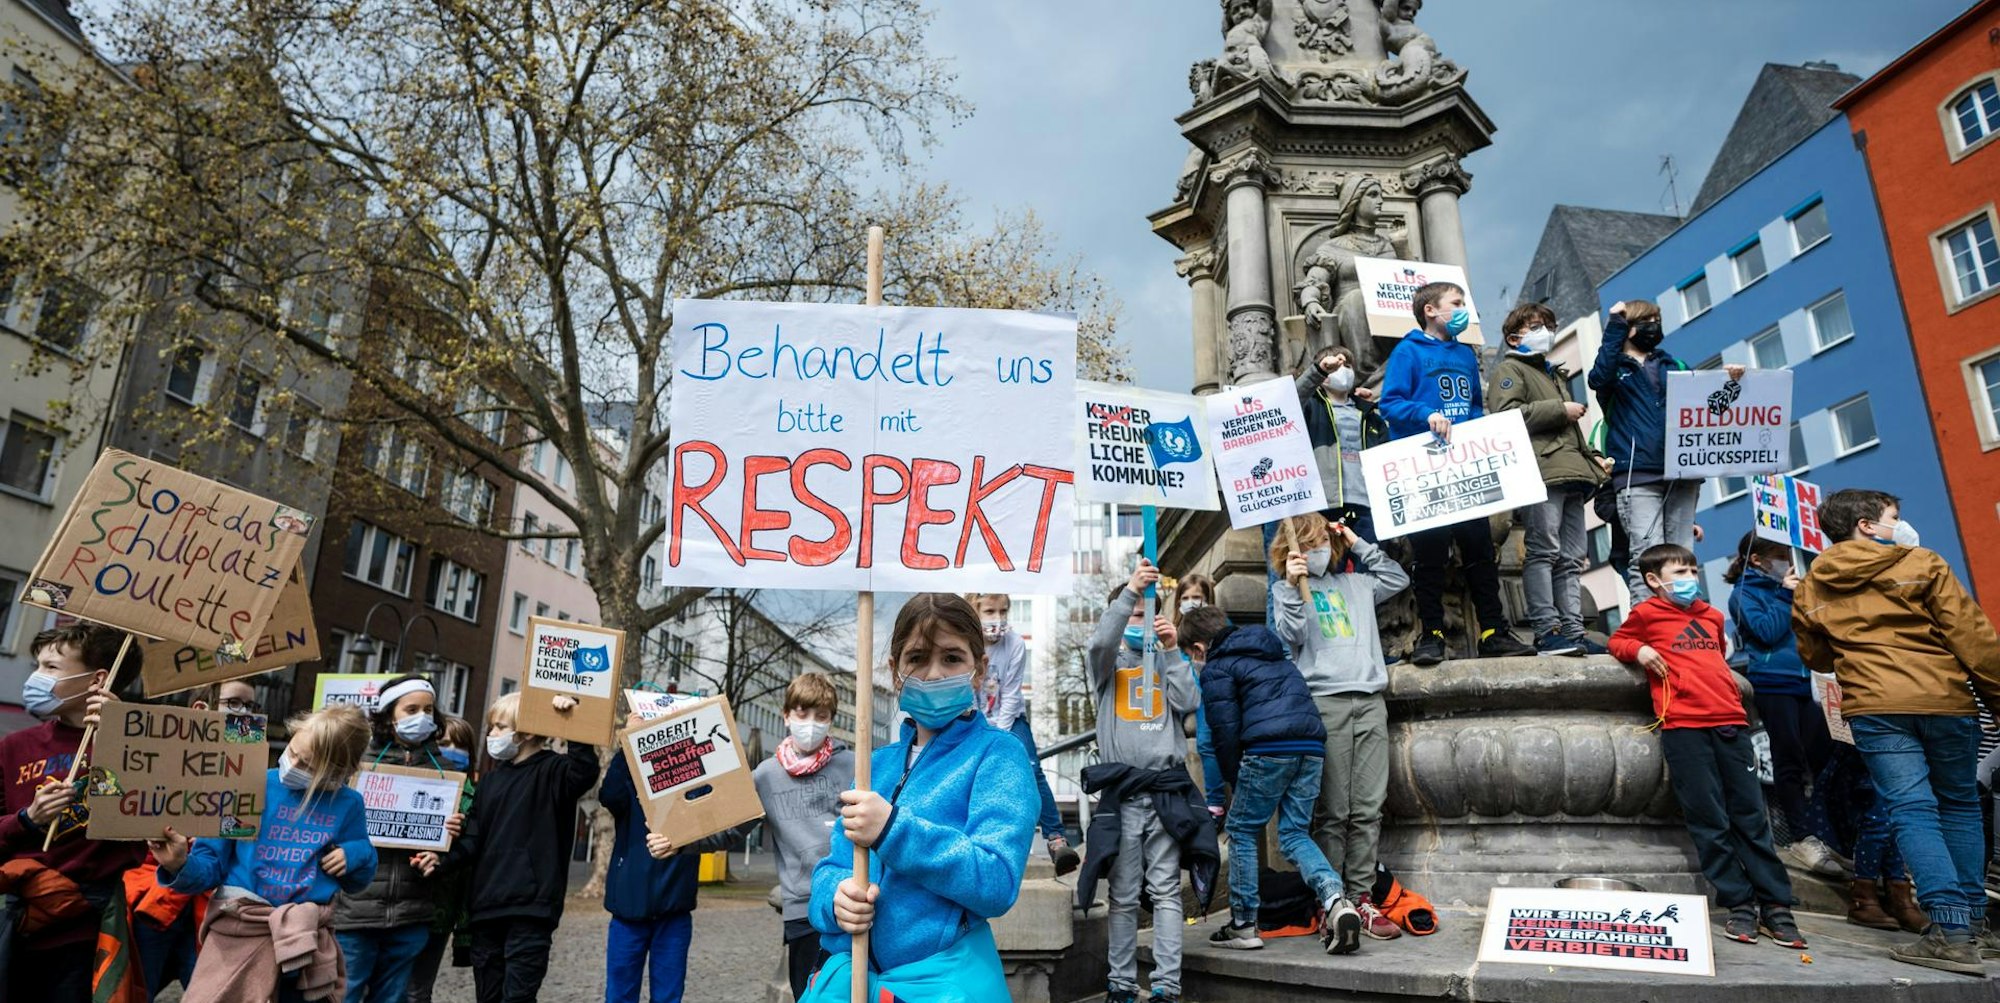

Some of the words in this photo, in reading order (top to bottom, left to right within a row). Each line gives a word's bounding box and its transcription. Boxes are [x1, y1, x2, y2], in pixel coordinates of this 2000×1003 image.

[1376, 291, 1414, 301] MACH
[1378, 282, 1420, 293] VERFA
[1377, 300, 1414, 311] BARB
[681, 322, 954, 387] Behandelt
[997, 355, 1053, 384] uns
[1438, 374, 1472, 402] 98
[777, 399, 844, 433] bitte
[880, 411, 923, 433] mit
[1234, 399, 1264, 417] LOS
[1679, 405, 1782, 428] BILDUNG
[1222, 407, 1282, 430] VERFAHREN
[1222, 420, 1264, 440] MACHEN
[1267, 416, 1289, 432] NUR
[1088, 422, 1155, 445] FREUND
[1678, 433, 1703, 448] IST
[1708, 432, 1742, 447] KEIN
[1090, 443, 1145, 464] LICHE
[1678, 449, 1779, 467] GLÜCKSSPIEL!
[1092, 464, 1185, 489] KOMMUNE?
[1233, 464, 1308, 492] BILDUNG
[1236, 490, 1256, 504] IST
[1257, 485, 1283, 500] KEIN
[1240, 489, 1312, 514] GLÜCKSSPIEL!
[1391, 490, 1433, 510] STAT
[1438, 474, 1499, 500] MANGEL
[669, 440, 1075, 574] RESPEKT
[1394, 492, 1485, 524] VRWALTEN!
[1671, 639, 1719, 651] adidas
[537, 658, 570, 671] LICHE
[535, 670, 594, 686] KOMMUNE?
[327, 694, 380, 707] SCHULP
[637, 718, 698, 749] ROBERT!
[653, 742, 714, 772] schaffen
[649, 771, 671, 784] STATT
[671, 760, 700, 775] KINDER
[651, 768, 700, 792] VERLOSEN!
[365, 774, 394, 792] FRAU
[406, 813, 430, 825] SOFORT
[430, 815, 444, 826] DAS
[268, 825, 334, 845] REASON
[367, 822, 441, 840] HULPLATZ-CASINO!
[256, 845, 314, 862] SOMEO
[257, 864, 317, 883] SMILS
[1513, 908, 1555, 920] WIR
[1557, 910, 1610, 921] SIND
[1511, 918, 1572, 929] KEINE
[1578, 921, 1663, 934] NIETEN!
[1510, 928, 1667, 946] LOSVERFAHREN
[1508, 938, 1689, 962] VERBIETEN!
